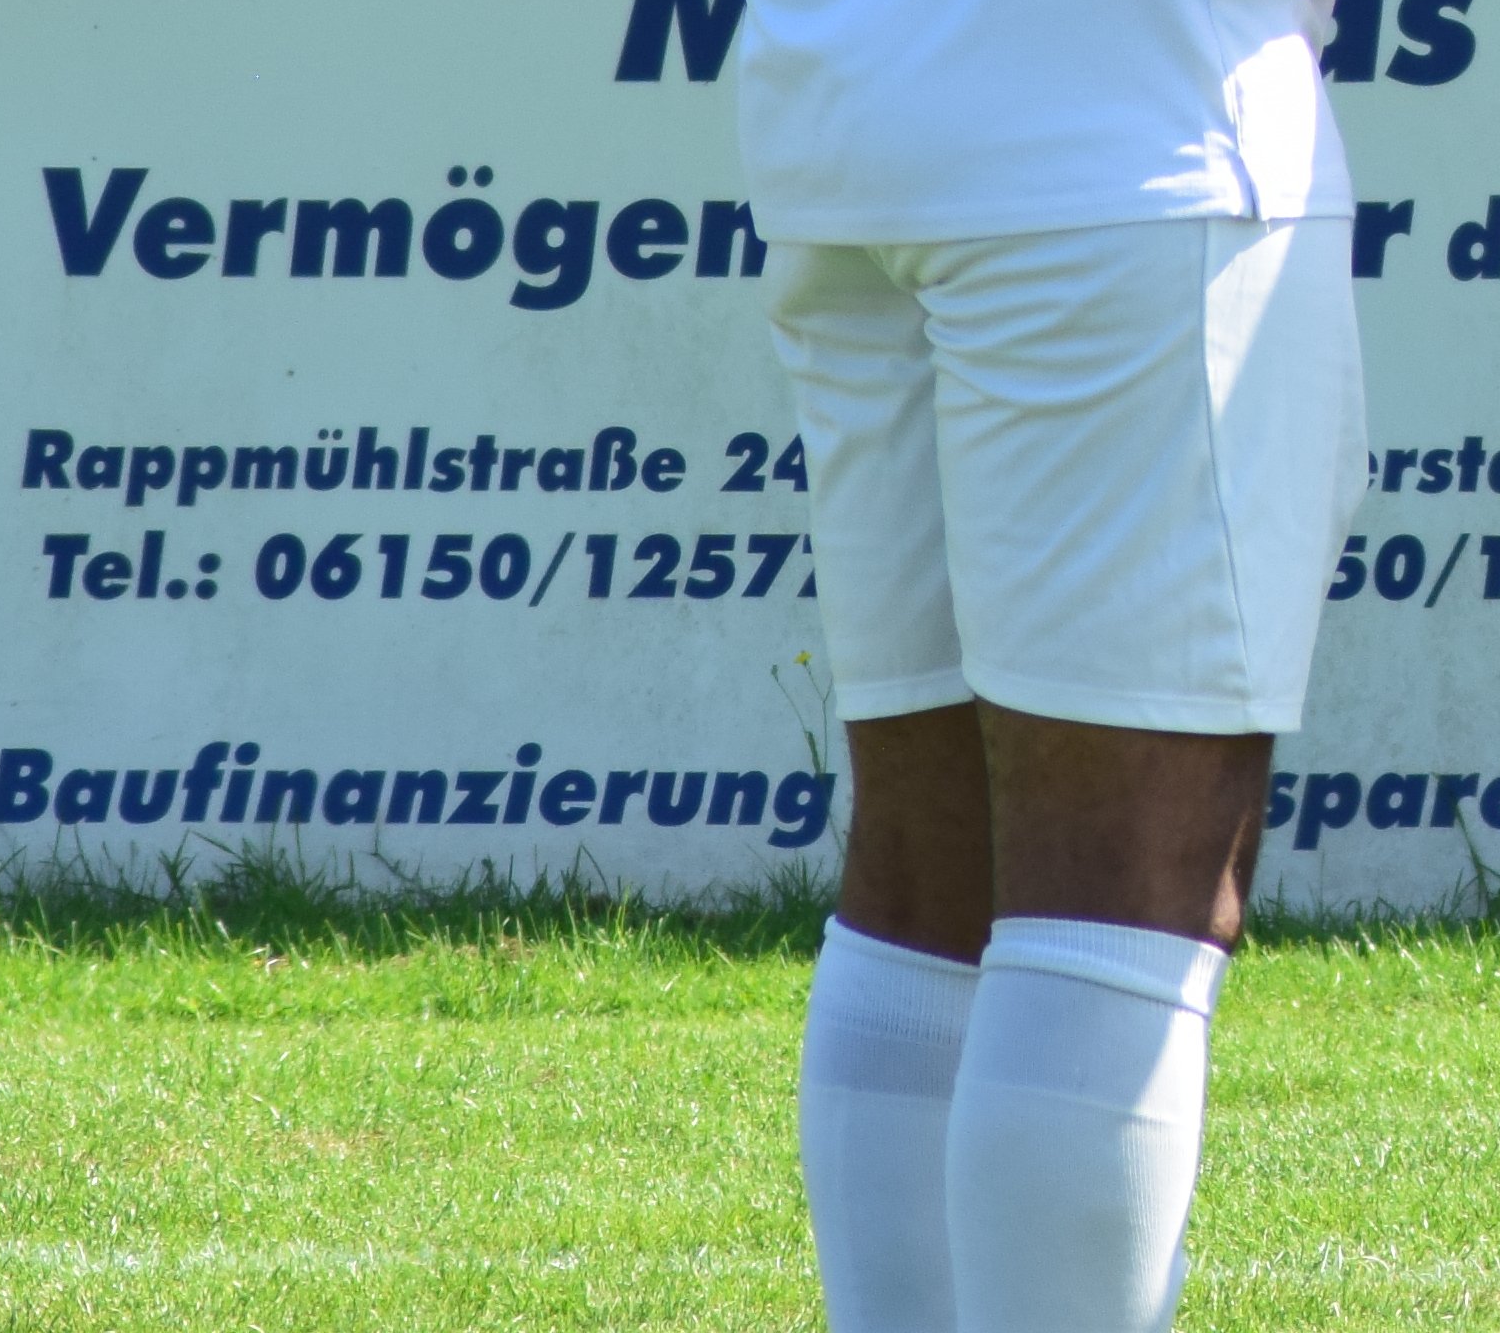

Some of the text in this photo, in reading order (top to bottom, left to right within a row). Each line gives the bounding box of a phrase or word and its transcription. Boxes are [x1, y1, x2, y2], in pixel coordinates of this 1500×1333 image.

[43, 166, 768, 310] Vermögen
[22, 426, 687, 507] Rappmühlstraße
[42, 529, 221, 601] Tel.:
